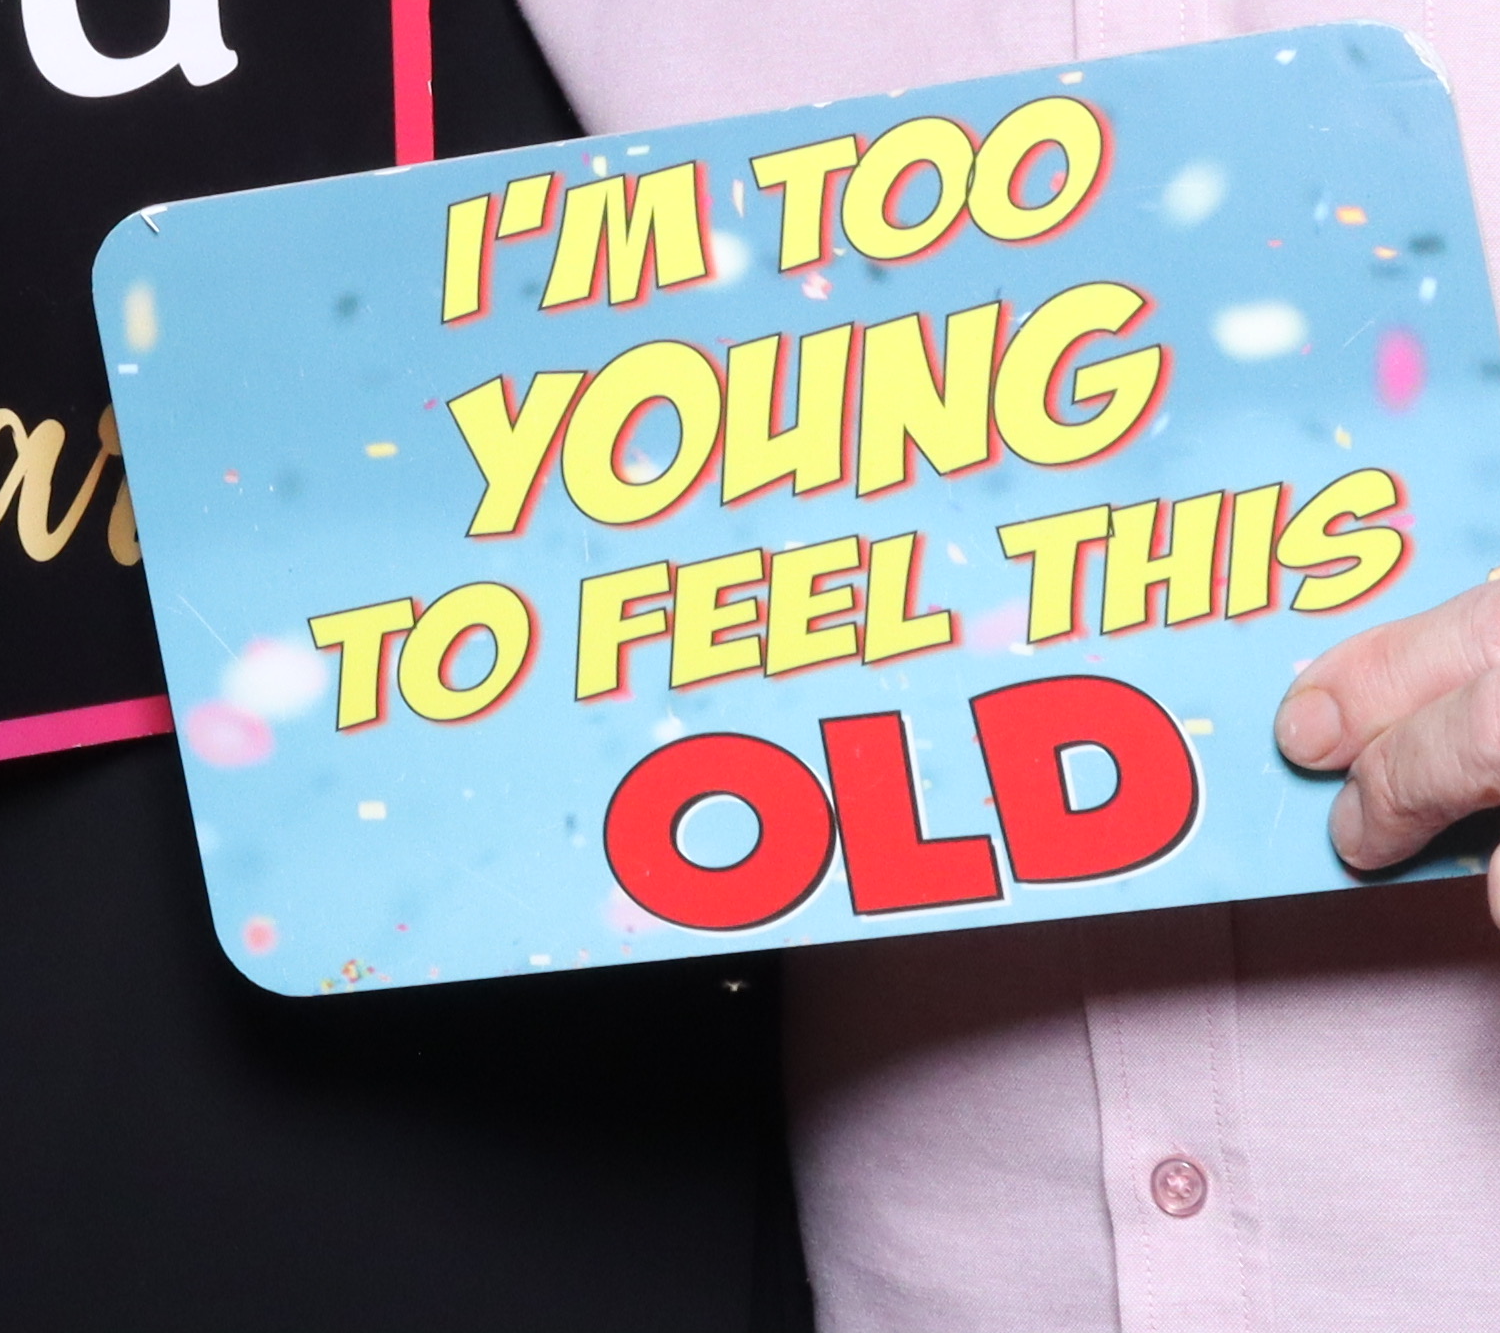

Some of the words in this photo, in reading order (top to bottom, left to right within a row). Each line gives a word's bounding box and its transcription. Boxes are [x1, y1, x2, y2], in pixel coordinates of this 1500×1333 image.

[443, 173, 710, 322] I'M
[752, 96, 1106, 271] TOO
[448, 282, 1166, 537] YOUNG
[309, 583, 534, 731] TO
[576, 535, 955, 701] FEEL
[999, 469, 1408, 645] THIS
[605, 675, 1198, 931] OLD
